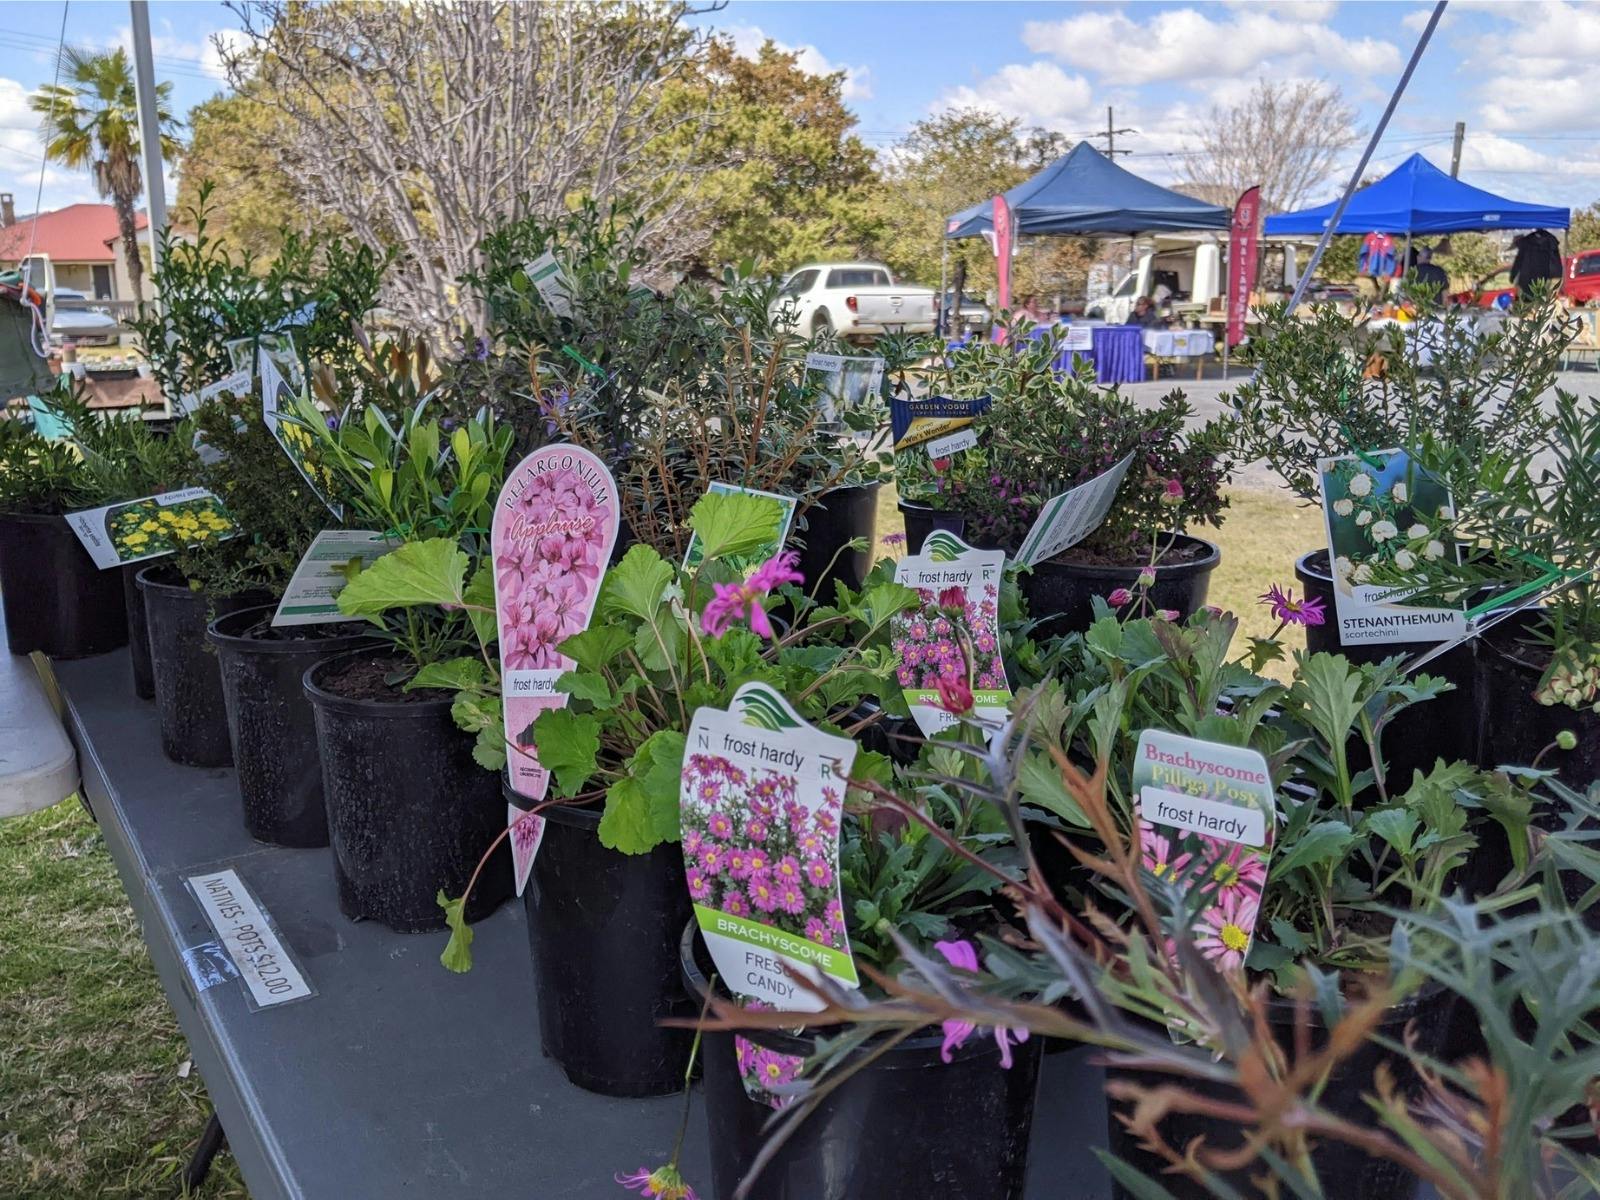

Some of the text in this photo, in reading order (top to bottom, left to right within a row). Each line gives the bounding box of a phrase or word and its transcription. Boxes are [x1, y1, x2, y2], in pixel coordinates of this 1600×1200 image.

[935, 439, 970, 456] frost hardy
[505, 455, 608, 509] PELARGONIUM
[164, 492, 185, 500] hardy
[511, 511, 594, 552] Applause
[919, 570, 972, 585] frost hardy
[1343, 612, 1454, 629] STENANTHEMUM
[1345, 628, 1399, 640] scortechinii
[513, 677, 555, 692] frost hardy
[919, 694, 998, 706] BRAOME
[723, 734, 805, 772] frost hardy
[1144, 743, 1266, 785] Brachyscome
[1152, 764, 1208, 795] Pilliga
[1157, 801, 1248, 840] frost hardy
[203, 878, 245, 919] NATIVES
[231, 923, 268, 954] POTS
[255, 953, 293, 996] $12.00
[717, 918, 833, 968] BRACHYSCOME
[745, 951, 793, 978] FRES
[746, 972, 795, 999] CANDY
